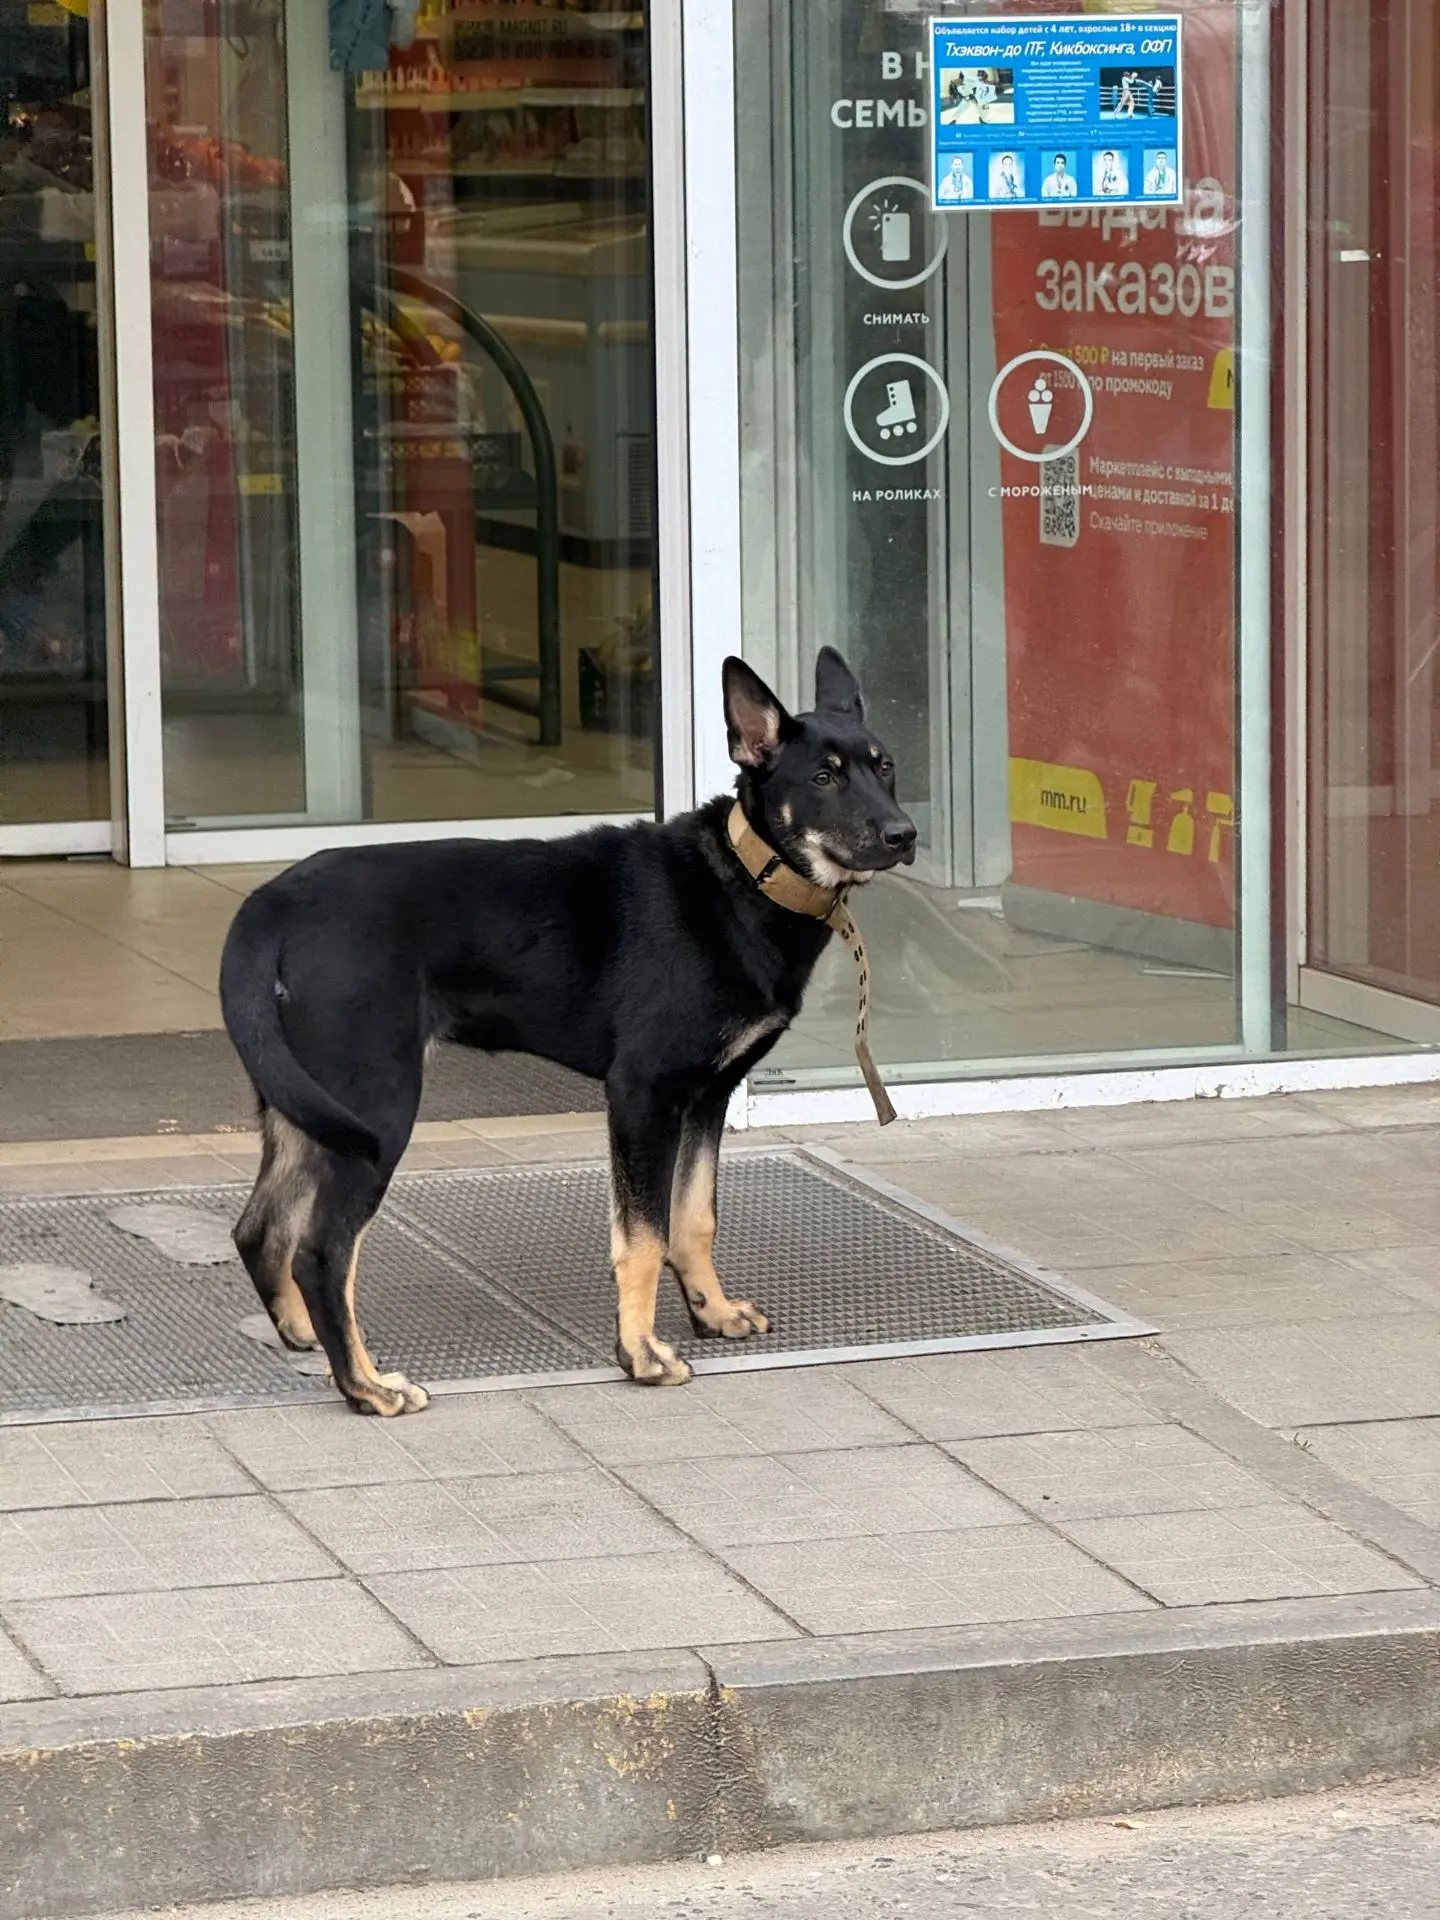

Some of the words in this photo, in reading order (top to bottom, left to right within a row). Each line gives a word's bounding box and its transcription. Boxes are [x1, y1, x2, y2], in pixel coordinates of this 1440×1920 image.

[934, 26, 989, 35] Объявляется
[991, 26, 1017, 35] набор
[1018, 25, 1043, 35] детей
[1050, 24, 1057, 33] 4
[1059, 25, 1077, 34] лет,
[1078, 26, 1118, 34] взрослых
[1120, 23, 1136, 32] 18+
[1144, 25, 1177, 33] секцию
[945, 42, 1022, 58] Тхэквон-до
[1024, 41, 1046, 57] ITF,
[1049, 40, 1136, 56] Кикбоксинга,
[1140, 39, 1173, 54] ОФП
[882, 51, 903, 79] В
[1035, 258, 1235, 318] заказов
[863, 313, 930, 325] СНИМАТЬ
[1075, 344, 1098, 365] 500
[1111, 350, 1128, 367] на
[1129, 349, 1174, 372] первый
[1175, 354, 1205, 371] заказ
[1105, 377, 1173, 400] промокоду
[1089, 456, 1165, 479] Маркетплейс
[1166, 466, 1173, 479] с
[1175, 466, 1233, 486] выгодными
[852, 490, 872, 501] НА
[876, 489, 943, 501] РОЛИКАХ
[988, 487, 996, 498] С
[1000, 485, 1093, 497] МОРОЖЕНЫМ
[1090, 484, 1133, 501] ценами
[1142, 489, 1197, 506] доставкой
[1198, 496, 1210, 510] за
[1210, 493, 1219, 510] 1
[1089, 511, 1143, 534] Скачайте
[1144, 519, 1209, 540] приложение
[1040, 788, 1086, 814] mm.ru
